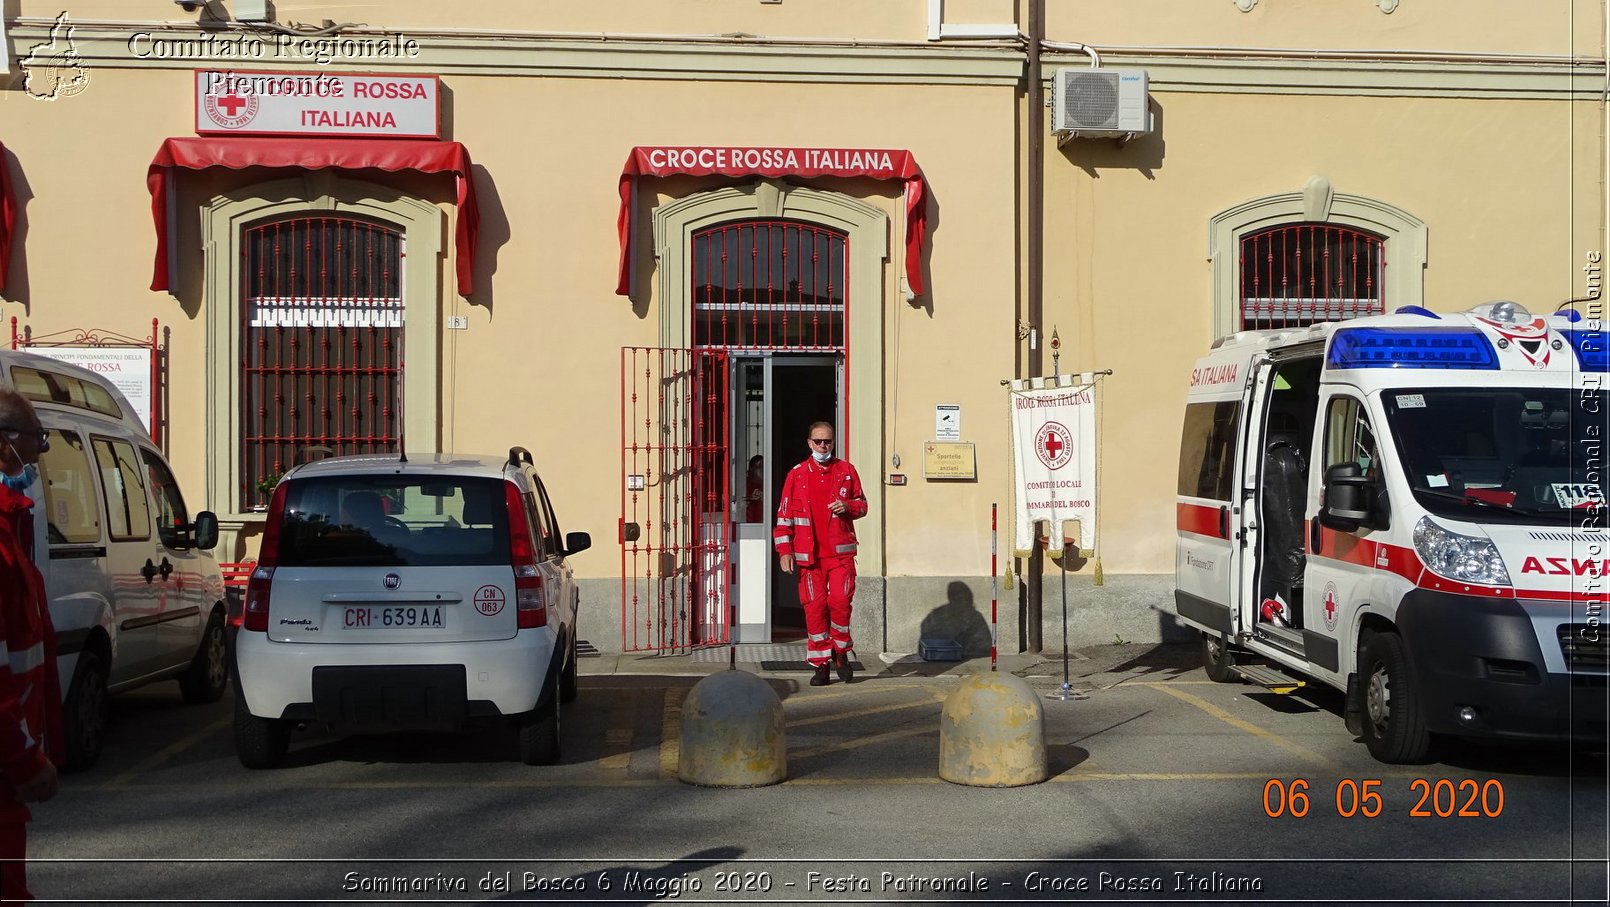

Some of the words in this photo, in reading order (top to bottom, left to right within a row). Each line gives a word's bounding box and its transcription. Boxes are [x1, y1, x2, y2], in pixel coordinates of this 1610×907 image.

[353, 81, 427, 100] ROSSA
[301, 109, 397, 128] ITALIANA
[650, 149, 726, 168] CROCE
[731, 149, 799, 169] ROSSA
[805, 150, 894, 171] ITALIANA
[87, 362, 122, 372] ROSSA
[1069, 500, 1090, 508] BOSCO
[484, 589, 496, 599] CN
[482, 602, 497, 612] 063
[345, 608, 371, 627] CRI
